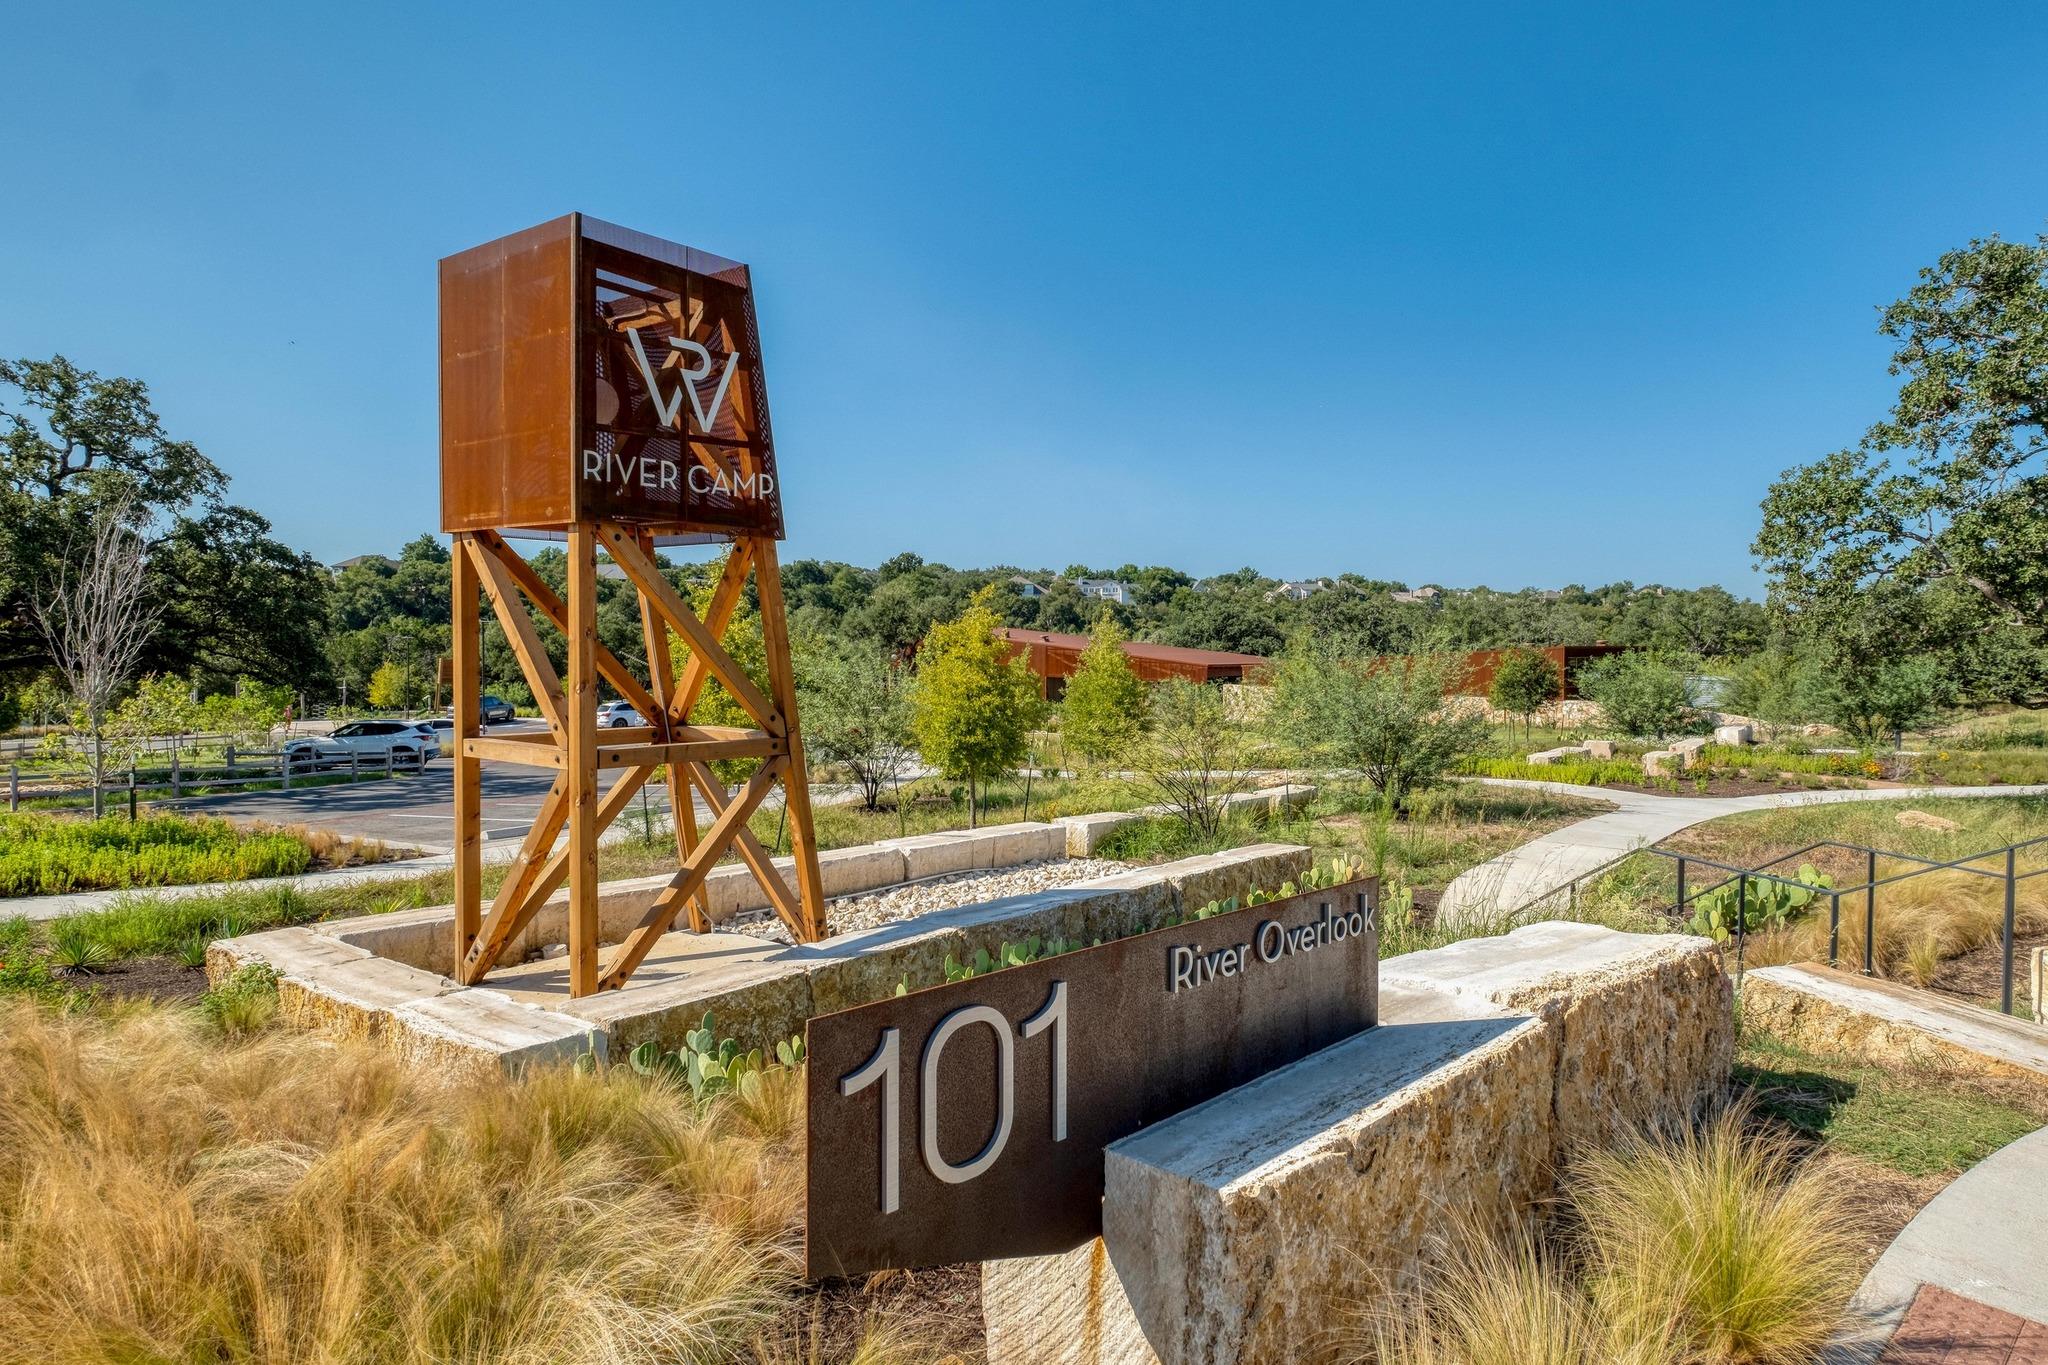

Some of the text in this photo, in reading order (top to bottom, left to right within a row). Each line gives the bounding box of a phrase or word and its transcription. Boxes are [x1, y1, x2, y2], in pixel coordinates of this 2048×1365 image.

[583, 449, 774, 500] RIVER CAMP
[841, 893, 1375, 1215] 101 River Overlook
